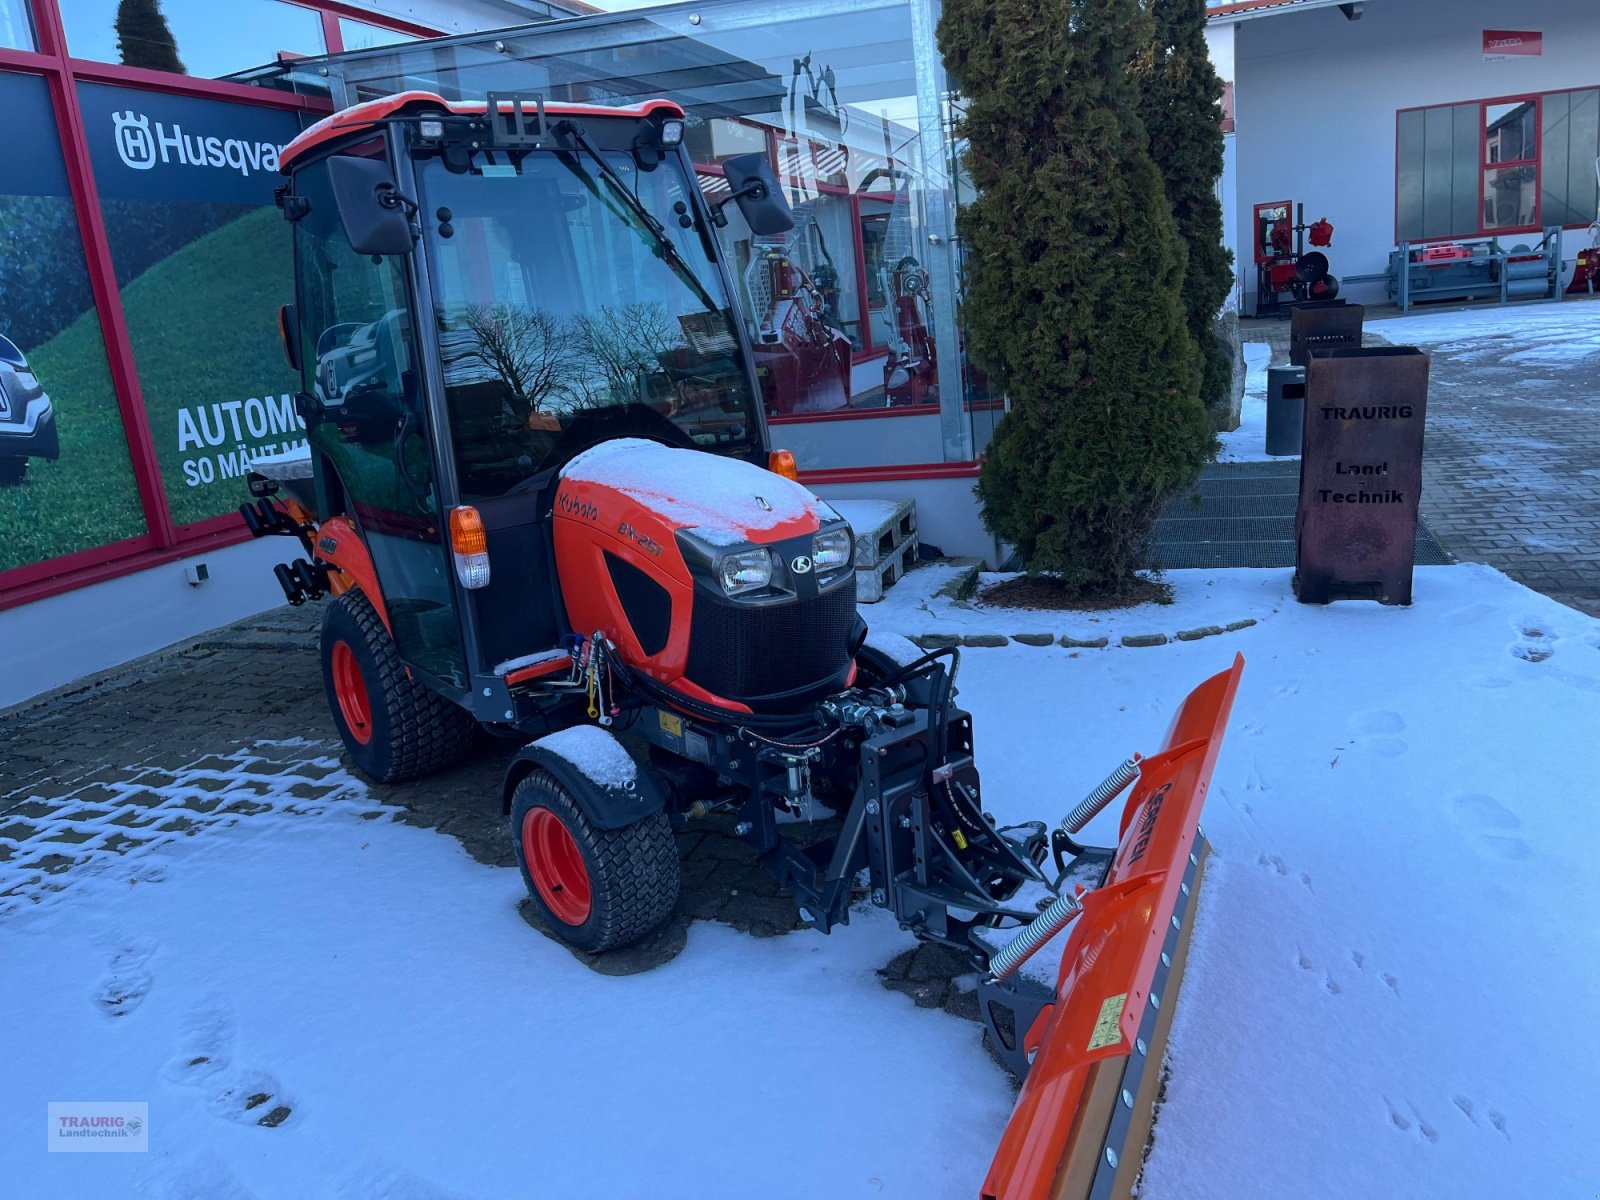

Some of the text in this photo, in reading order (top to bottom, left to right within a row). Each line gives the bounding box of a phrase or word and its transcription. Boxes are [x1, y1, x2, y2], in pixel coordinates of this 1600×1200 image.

[1320, 406, 1413, 420] TRAURIG
[183, 457, 214, 487] SO
[1336, 462, 1387, 475] Land
[1318, 489, 1403, 503] Technik
[559, 491, 598, 521] Kubota
